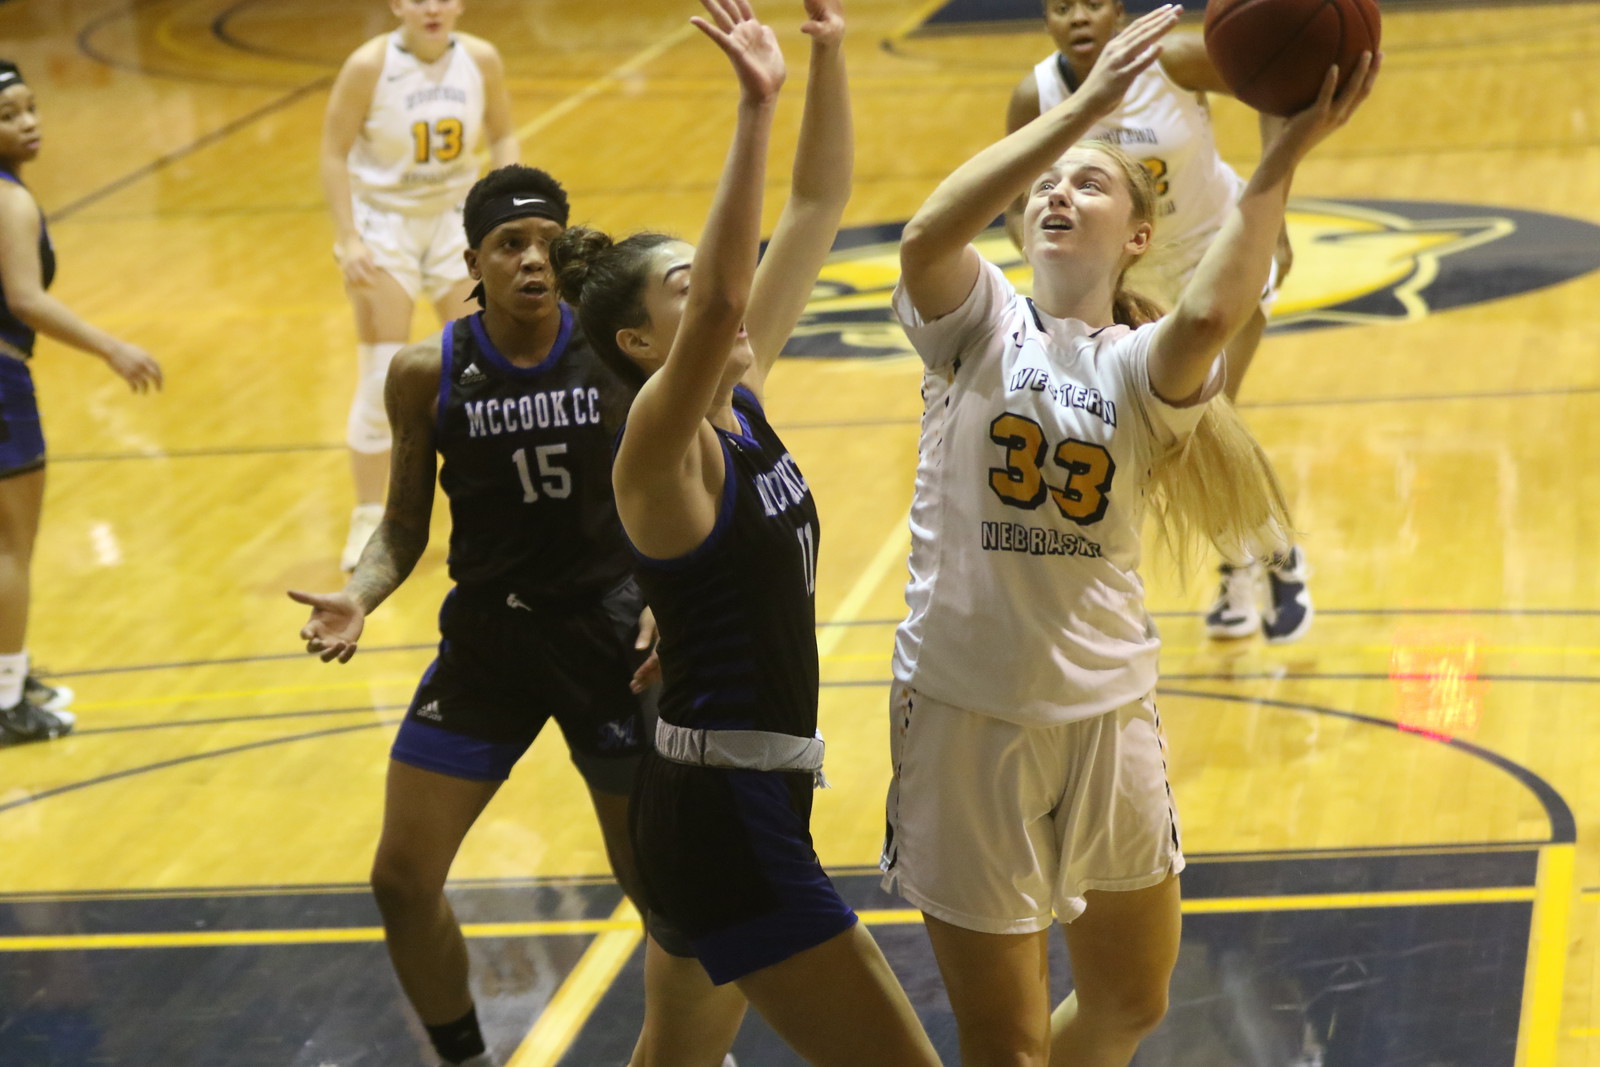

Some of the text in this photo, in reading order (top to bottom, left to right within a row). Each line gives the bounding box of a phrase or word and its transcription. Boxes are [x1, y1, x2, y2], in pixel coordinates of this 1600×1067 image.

[411, 118, 463, 163] 13
[465, 387, 600, 437] MCCOOK CC
[512, 443, 571, 503] 15
[989, 411, 1116, 526] 33
[981, 521, 1102, 558] NEBRASK
